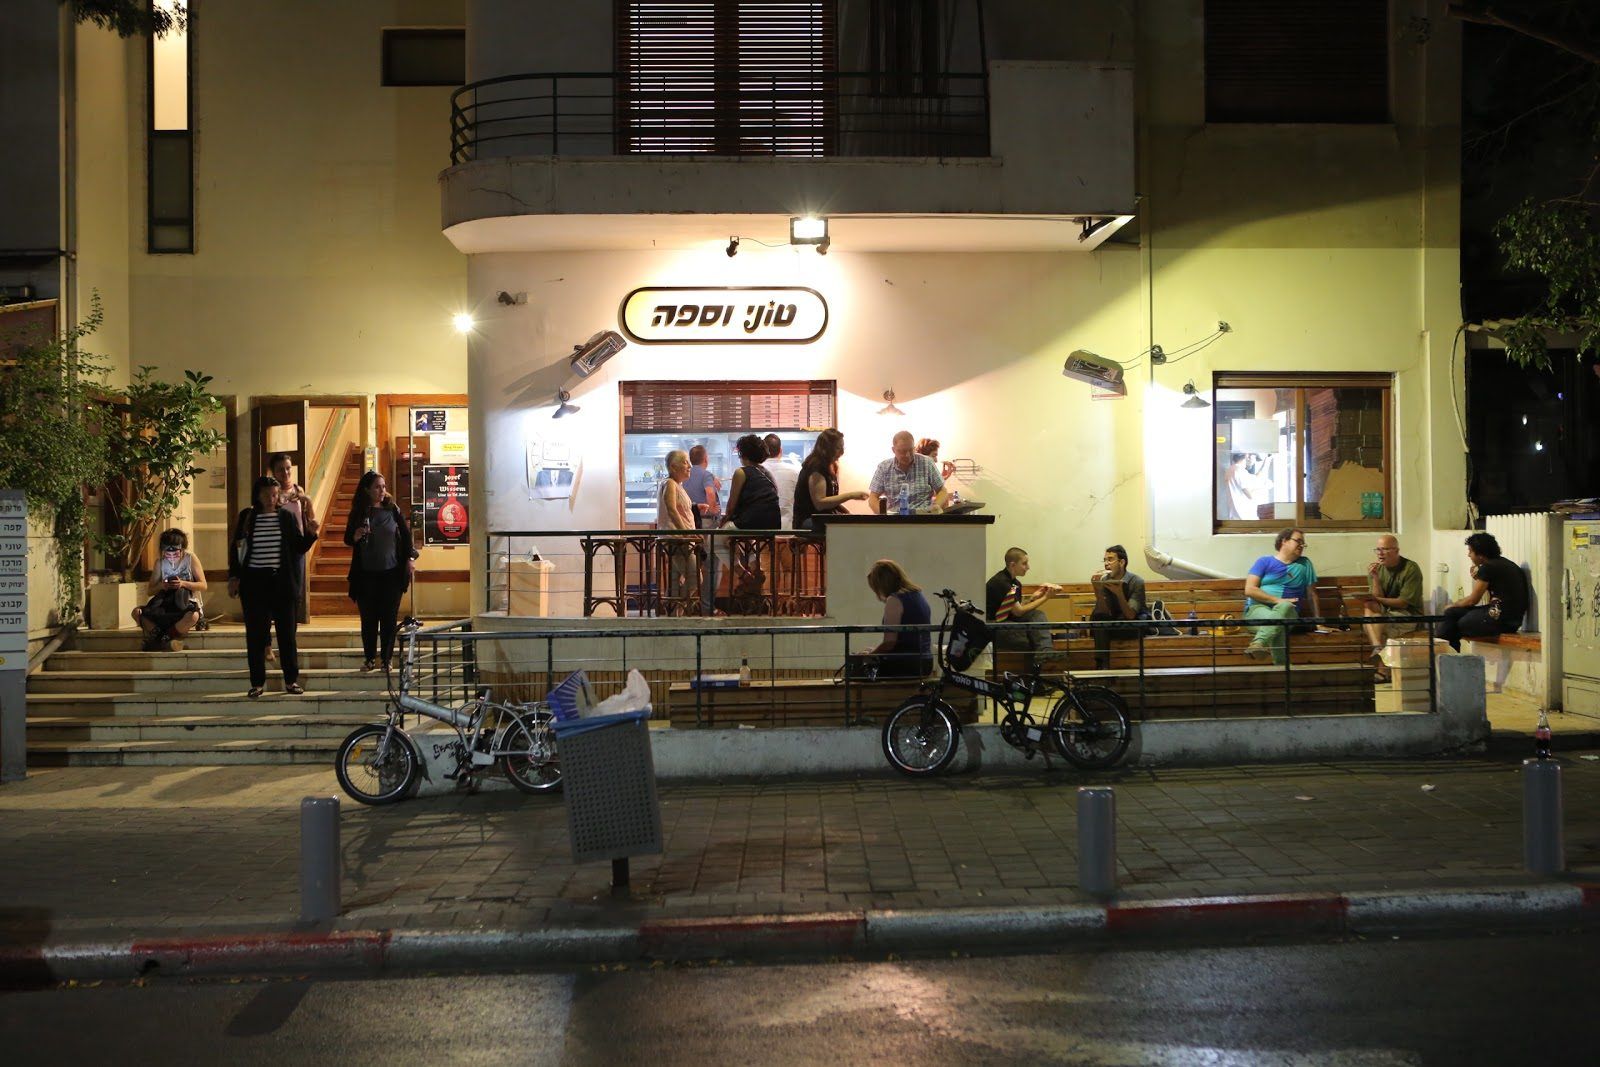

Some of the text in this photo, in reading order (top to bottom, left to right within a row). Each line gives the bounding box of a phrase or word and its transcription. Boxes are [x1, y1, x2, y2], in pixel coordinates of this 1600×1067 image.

[651, 301, 798, 333] טוני וספה
[3, 524, 22, 532] קפה
[5, 543, 22, 551] טוני
[1, 559, 22, 567] מרכז
